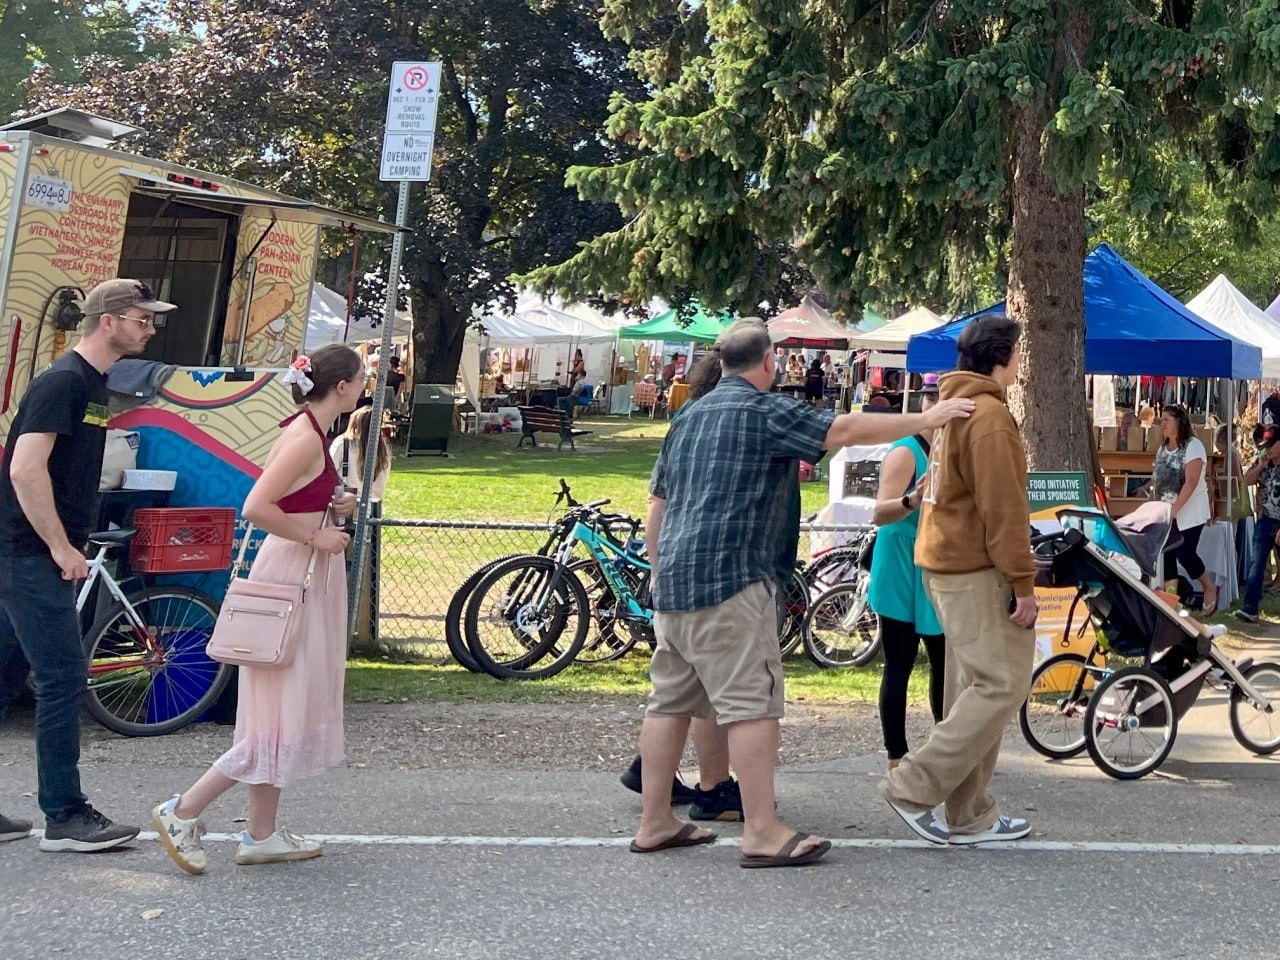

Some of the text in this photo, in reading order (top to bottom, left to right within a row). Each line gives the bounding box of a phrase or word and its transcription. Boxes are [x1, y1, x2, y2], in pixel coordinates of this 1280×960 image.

[397, 113, 426, 121] REMOVAL
[403, 137, 414, 148] NO
[386, 151, 428, 163] OVERNIGHT
[389, 165, 421, 177] CAMPING
[71, 192, 123, 209] THE CULINARY
[69, 204, 120, 222] OSSROADS OF
[59, 216, 121, 236] CONTEMPORARY
[97, 251, 113, 263] AND
[259, 246, 301, 264] PAN-ASIAN
[51, 257, 112, 276] KOREAN STREET
[258, 262, 293, 278] CANTEEN
[1029, 479, 1080, 490] FOOD INITIATIVE
[1027, 491, 1080, 501] THEIR SPONSORS
